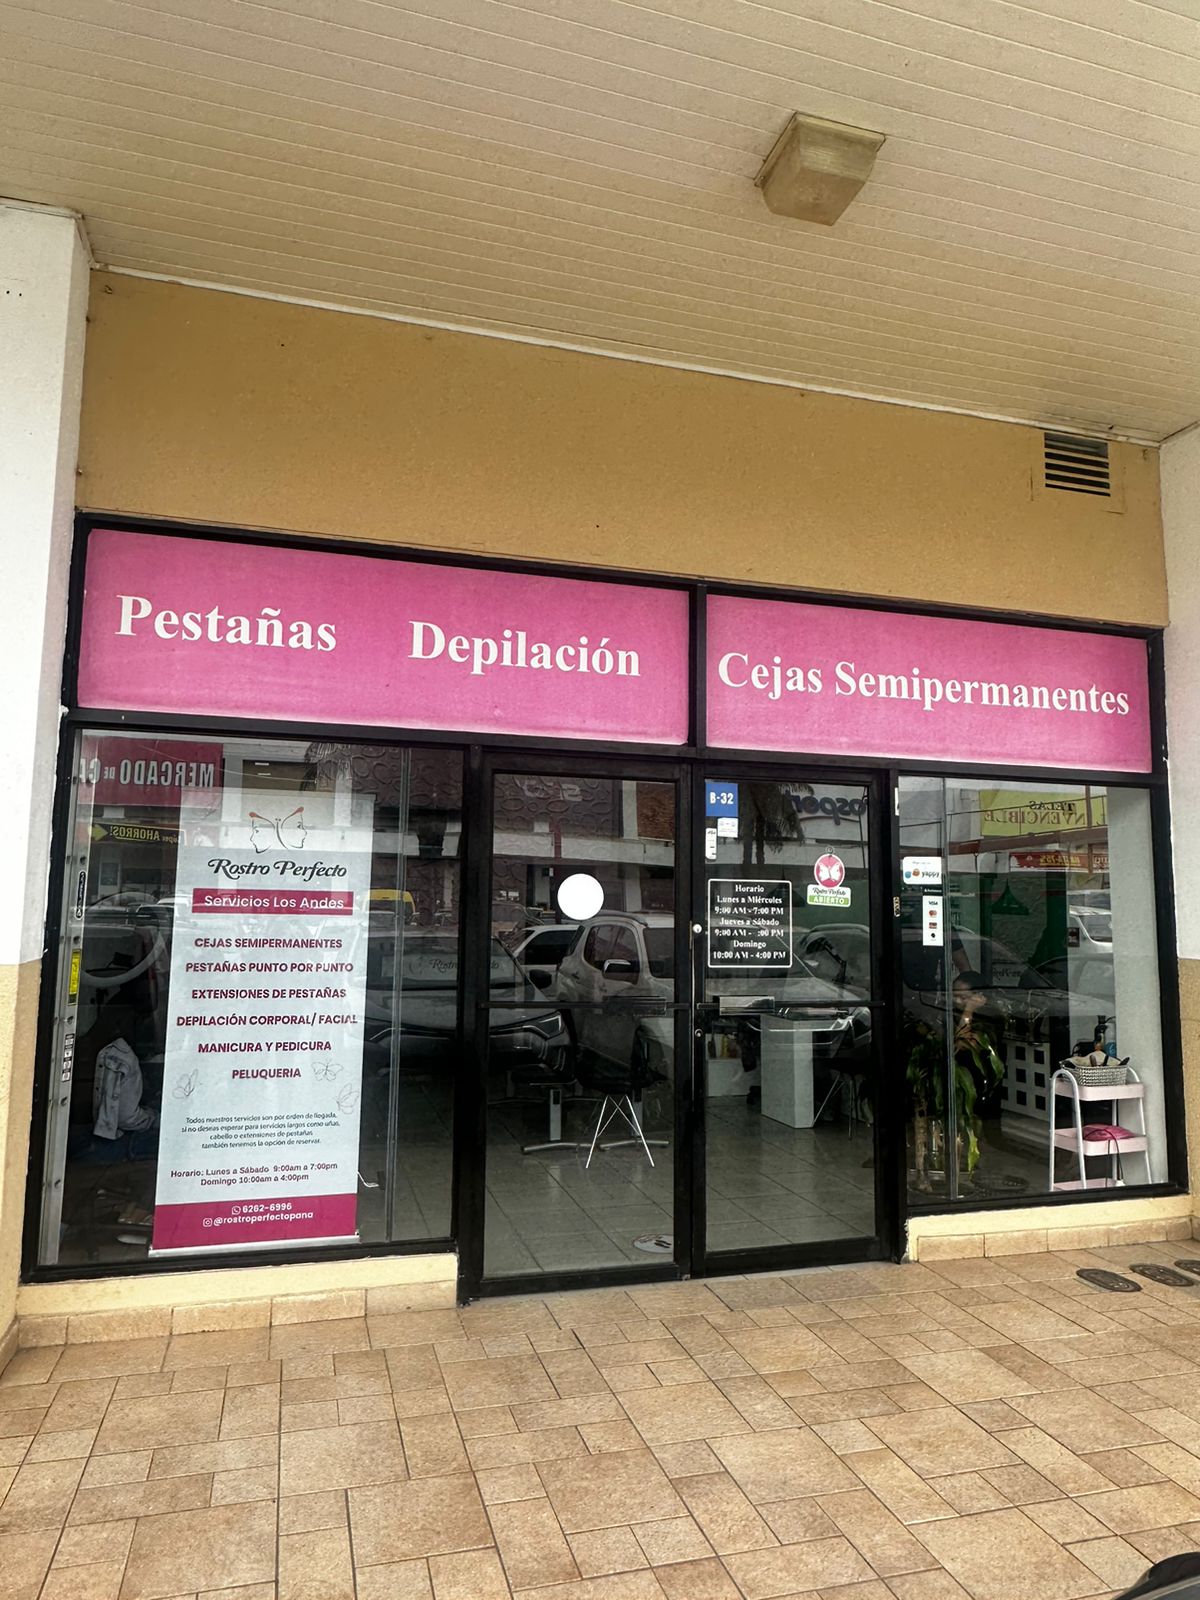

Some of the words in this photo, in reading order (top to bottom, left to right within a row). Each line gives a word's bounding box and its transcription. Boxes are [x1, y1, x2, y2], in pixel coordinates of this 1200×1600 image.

[115, 594, 337, 652] Pestañas
[407, 620, 641, 677] Depilación
[718, 652, 823, 700] Cejas
[835, 661, 1129, 715] Semipermanentes
[710, 792, 734, 805] B-32
[208, 859, 271, 880] Rostro
[273, 860, 347, 882] Perfecto
[735, 885, 765, 893] Horario
[205, 895, 270, 908] Servicios
[274, 897, 296, 908] Los
[300, 897, 344, 909] Andes
[717, 895, 739, 903] Lunes
[714, 906, 731, 914] 9:00
[771, 907, 784, 915] PM
[719, 917, 745, 925] Jueves
[752, 918, 779, 926] Sábado
[194, 938, 232, 948] CEJAS
[234, 938, 343, 949] SEMIPERMANENTES
[733, 940, 766, 949] Domingo
[713, 951, 733, 959] 10:00
[755, 951, 771, 959] 4:00
[186, 961, 247, 972] PESTAÑAS
[248, 962, 288, 972] PUNTO
[290, 963, 313, 972] POR
[315, 963, 354, 972] PUNTO
[192, 989, 270, 999] EXTENSIONES
[272, 989, 287, 999] DE
[289, 987, 347, 998] PESTAÑAS
[176, 1013, 247, 1026] DEPILACIÓN
[248, 1012, 317, 1026] CORPORAL/
[318, 1014, 359, 1024] FACIAL
[198, 1042, 263, 1053] MANICURA
[265, 1042, 274, 1051] Y
[275, 1041, 332, 1051] PEDICURA
[232, 1068, 302, 1079] PELUQUERIA
[244, 1123, 259, 1131] para
[277, 1130, 286, 1138] de
[171, 1169, 204, 1178] Horario:
[205, 1168, 230, 1176] Lunes
[240, 1165, 270, 1174] Sábado
[310, 1163, 338, 1171] 7:00pm
[200, 1178, 237, 1186] Domingo
[239, 1176, 272, 1184] 10:00am
[280, 1174, 309, 1182] 4:00pm
[213, 1211, 314, 1226] @rostroperfectopana
